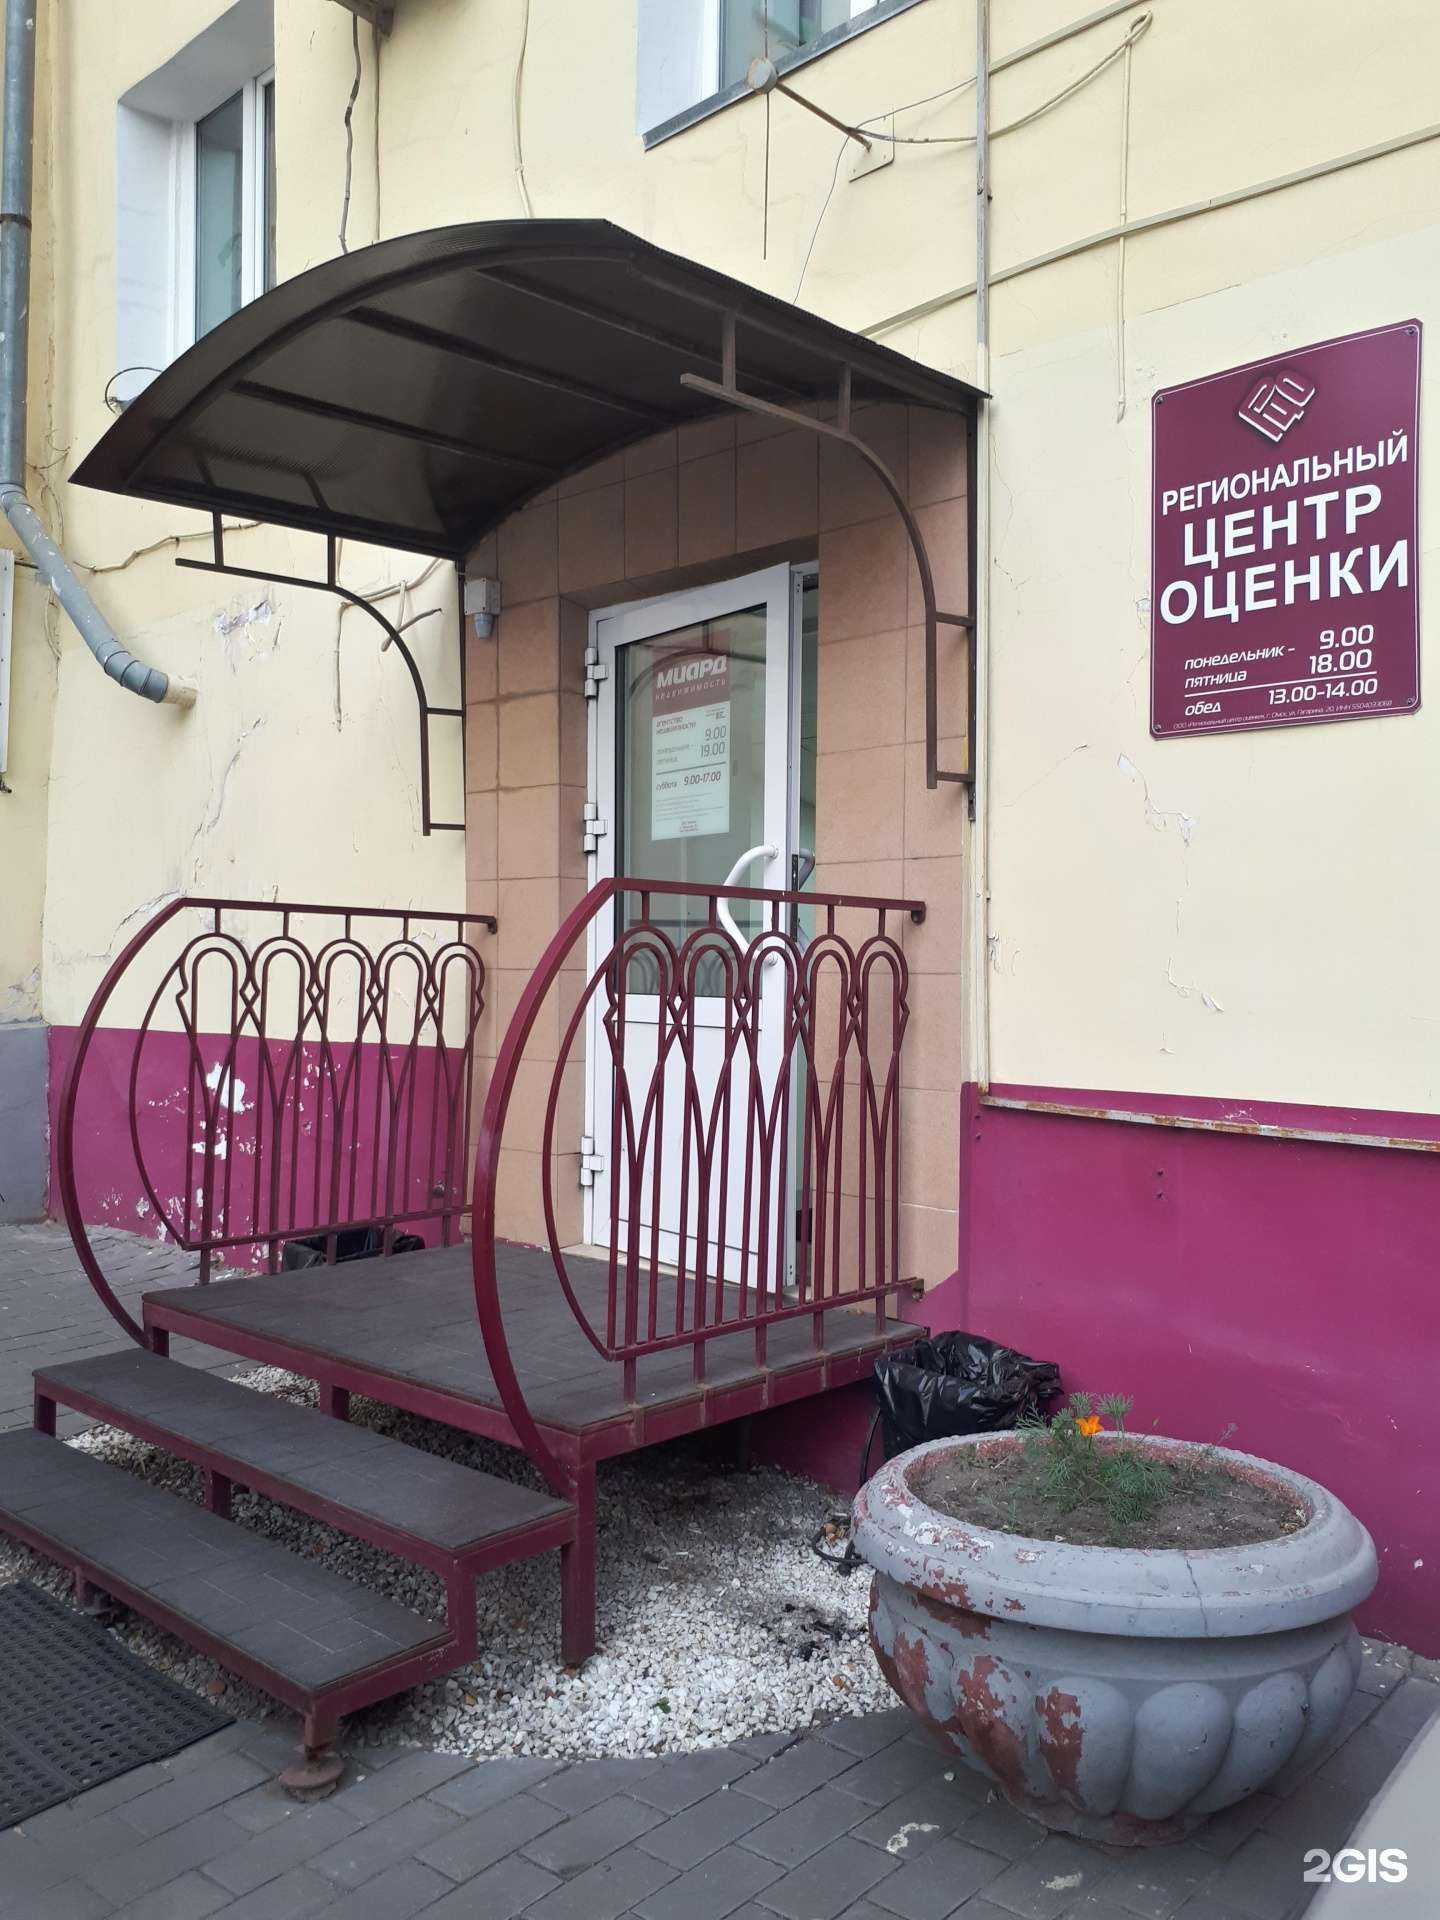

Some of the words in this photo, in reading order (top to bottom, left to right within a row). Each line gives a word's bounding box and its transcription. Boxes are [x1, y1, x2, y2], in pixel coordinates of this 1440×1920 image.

[1162, 428, 1409, 516] РЕГИОНАЛЬНЫЙ
[1183, 483, 1383, 570] ЦЕНТР
[1160, 539, 1409, 626] ОЦЕНКИ
[1319, 625, 1375, 651] 9.00
[1184, 645, 1285, 671] понедельник
[1310, 649, 1373, 674] 18.00
[1184, 669, 1248, 689] пятница
[1268, 678, 1378, 706] 13.00-14.00
[1185, 702, 1222, 717] обед
[700, 741, 726, 759] 19.00
